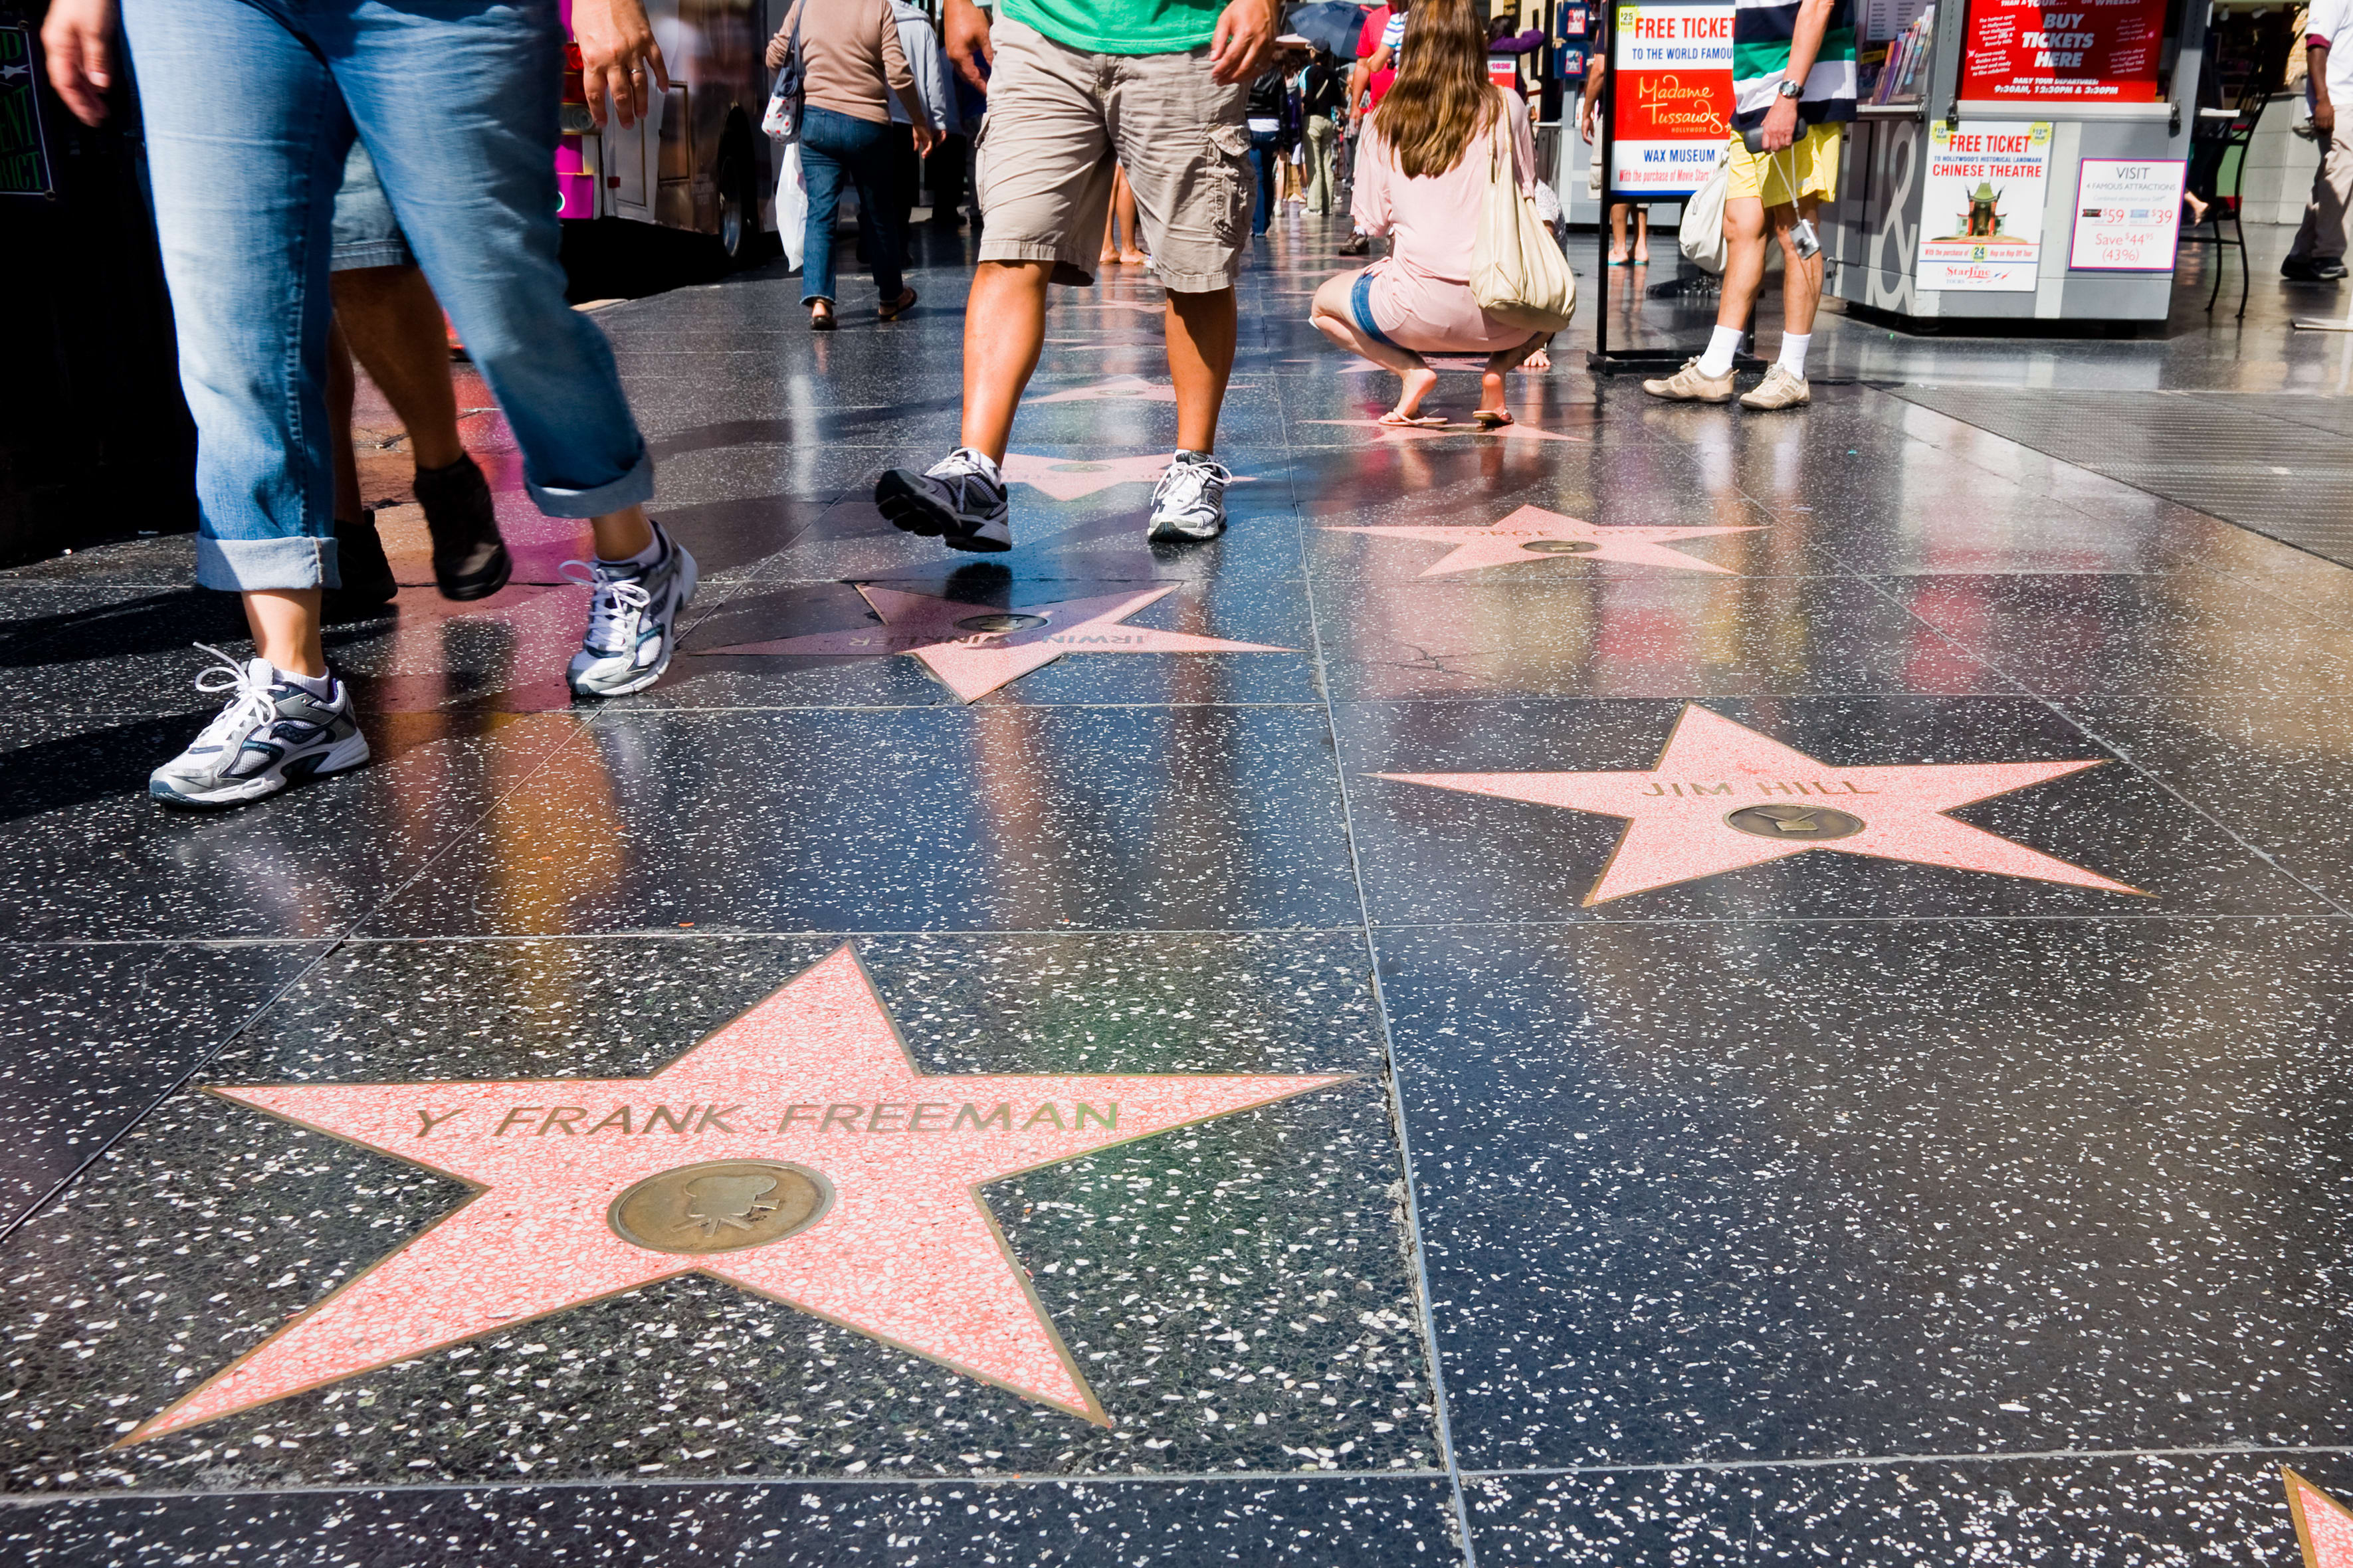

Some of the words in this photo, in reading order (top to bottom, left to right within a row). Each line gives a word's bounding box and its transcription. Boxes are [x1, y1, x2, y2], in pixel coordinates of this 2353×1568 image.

[1635, 17, 1675, 39] FREE
[1682, 17, 1736, 38] TICKET
[2043, 13, 2085, 29] BUY
[2022, 32, 2095, 48] TICKETS
[1633, 48, 1643, 60] TO
[1647, 48, 1663, 60] THE
[1667, 48, 1698, 59] WORLD
[1701, 47, 1733, 59] FAMOU
[2034, 51, 2084, 68] HERE
[1639, 74, 1714, 102] Madame
[2034, 85, 2073, 94] 12:30PM
[1641, 100, 1723, 134] Tussauds
[1949, 134, 1982, 152] FREE
[1986, 135, 2031, 152] TICKET
[1643, 149, 1666, 162] WAX
[1669, 149, 1715, 162] MUSEUM
[1619, 169, 1631, 182] With
[1633, 169, 1641, 181] the
[1643, 169, 1669, 184] purchase
[1670, 169, 1676, 181] of
[1677, 169, 1693, 181] Movie
[1933, 164, 1984, 176] CHINESE
[1989, 165, 2042, 177] THEATRE
[2116, 167, 2150, 179] VISIT
[2102, 208, 2124, 223] $59
[2152, 209, 2173, 224] $39
[2095, 233, 2123, 245] Save
[1974, 246, 1984, 256] 24
[2102, 248, 2140, 263] (43%)
[847, 631, 1014, 648] WINKLER
[1042, 635, 1145, 644] IRWIN
[1642, 782, 1734, 797] JIM
[1756, 780, 1879, 796] HILL
[415, 1106, 468, 1139] Y
[492, 1104, 746, 1137] FRANK
[777, 1100, 1120, 1135] FREEMAN
